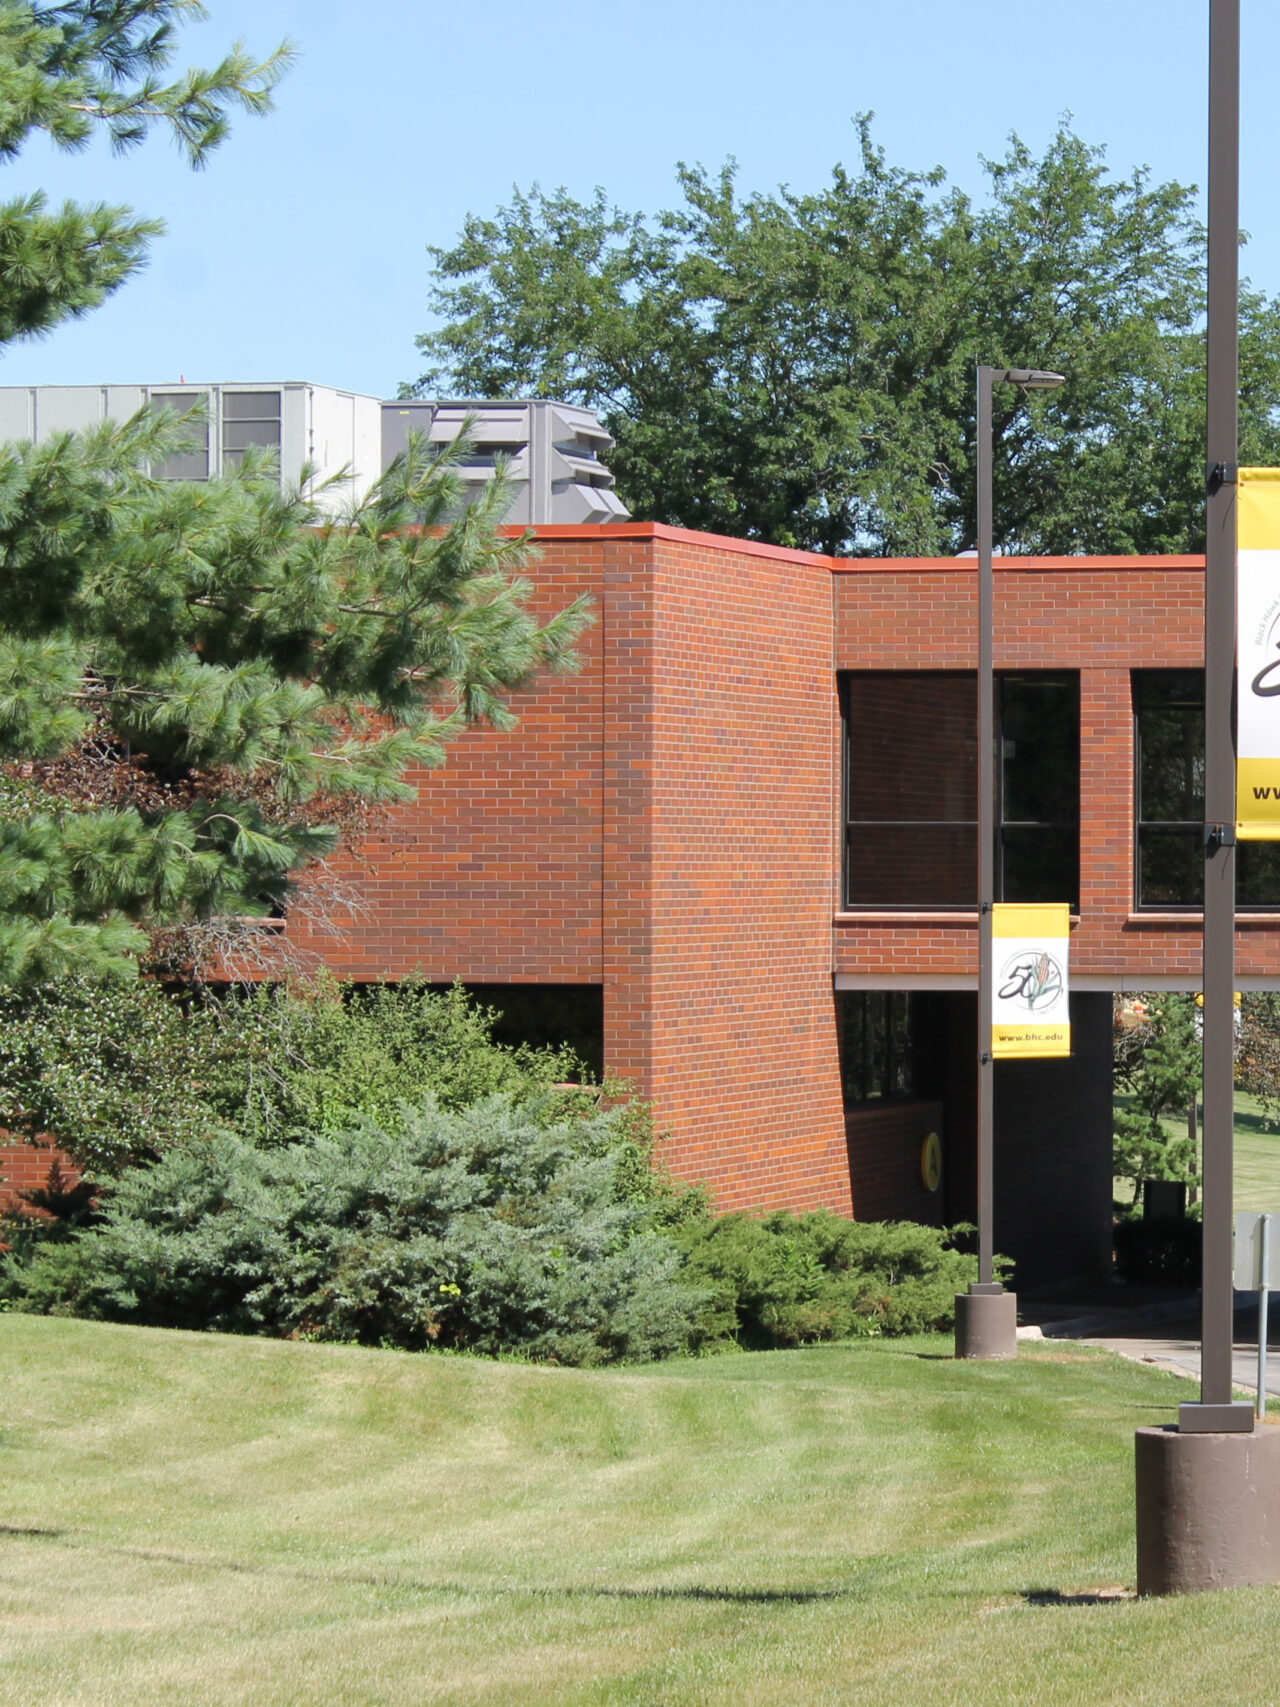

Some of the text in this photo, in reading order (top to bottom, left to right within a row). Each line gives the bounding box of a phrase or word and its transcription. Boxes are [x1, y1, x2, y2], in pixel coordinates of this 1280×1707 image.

[1254, 622, 1267, 646] Black
[1263, 600, 1280, 621] Hawk
[999, 1033, 1063, 1042] www.bhc.edu
